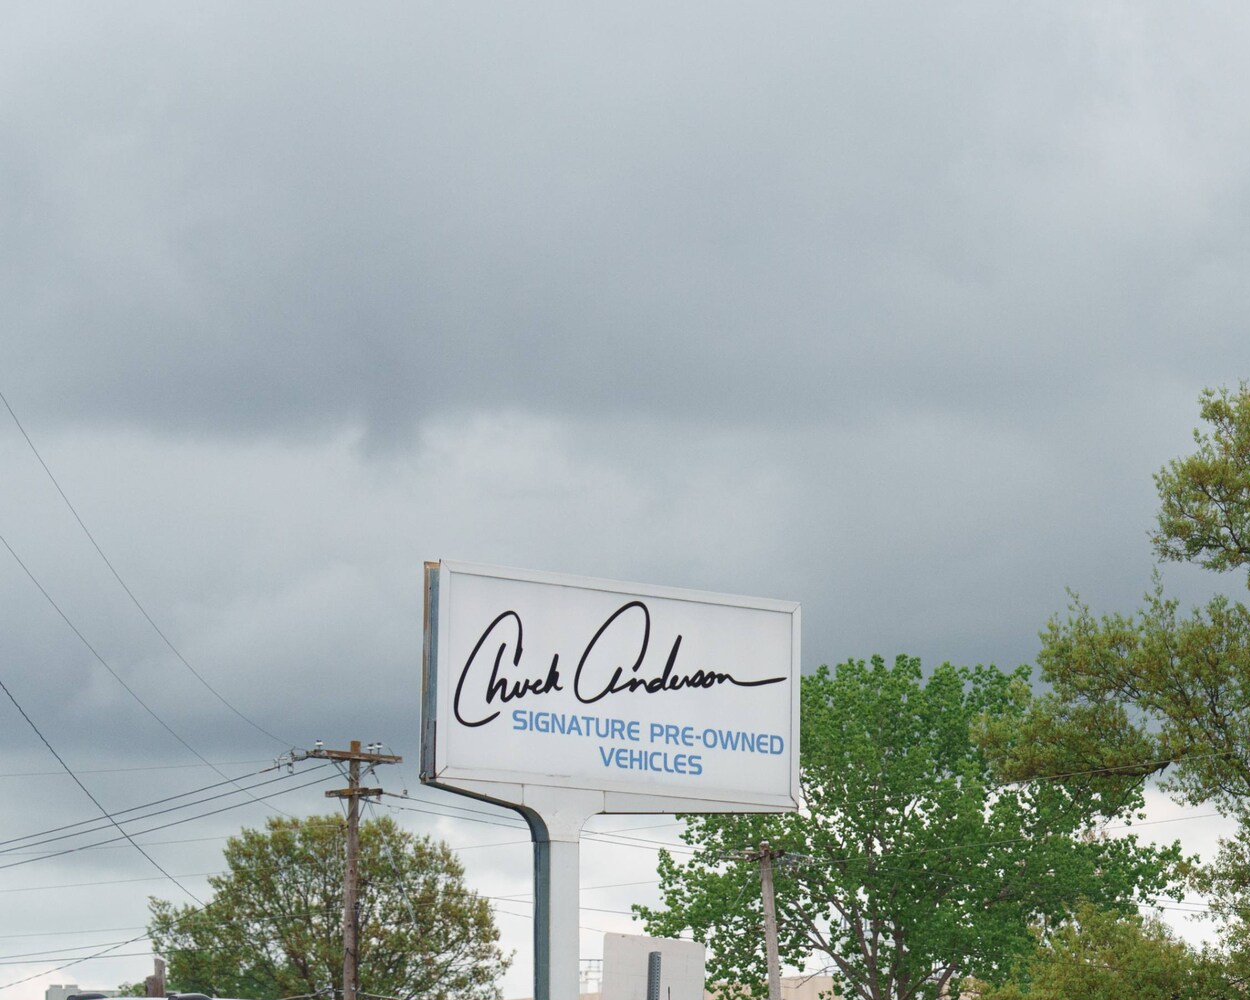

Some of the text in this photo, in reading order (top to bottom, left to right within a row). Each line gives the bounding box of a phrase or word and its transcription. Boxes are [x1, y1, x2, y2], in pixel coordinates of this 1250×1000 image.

[454, 600, 787, 727] Chuck Anderson
[512, 709, 785, 756] SIGNATURE PRE-OWNED
[599, 746, 703, 776] VEHICLES
